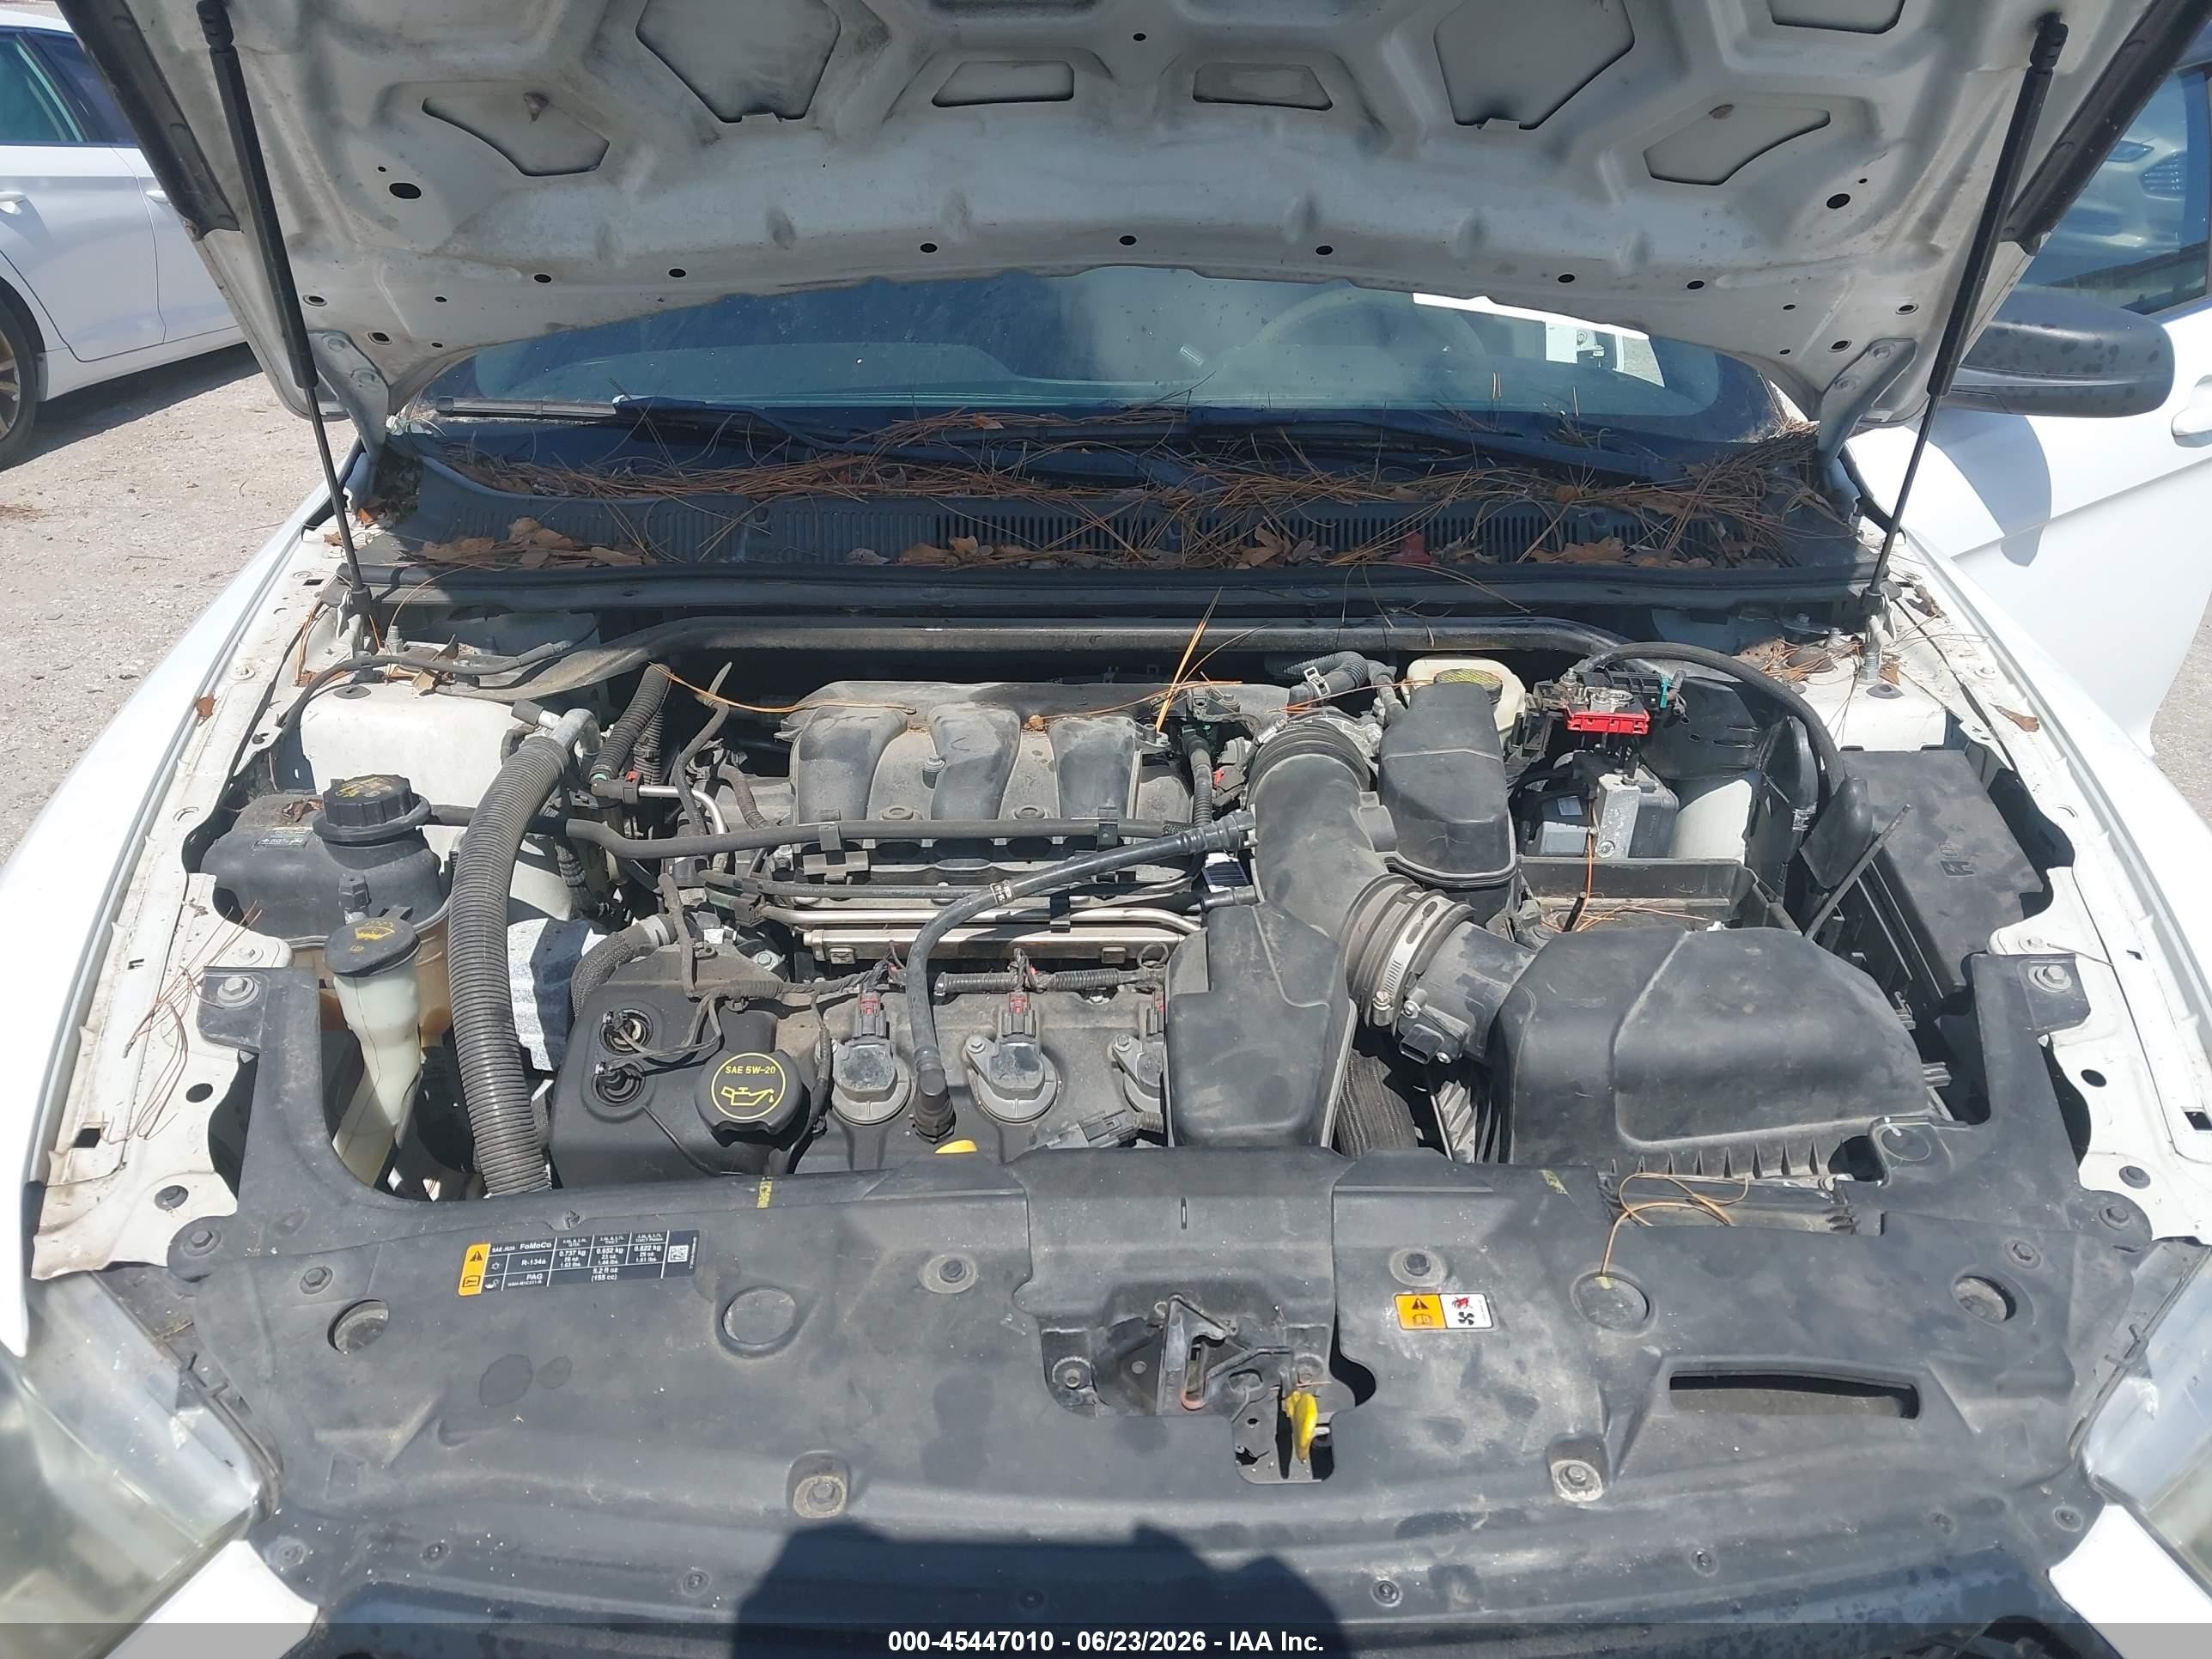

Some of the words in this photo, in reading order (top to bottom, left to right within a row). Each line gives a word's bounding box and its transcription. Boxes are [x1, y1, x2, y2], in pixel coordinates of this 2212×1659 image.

[725, 1066, 744, 1074] SAE
[745, 1066, 776, 1074] 5W-20
[520, 1242, 551, 1250] FoMoCo
[526, 1273, 543, 1281] PAG
[591, 1274, 605, 1283] (155
